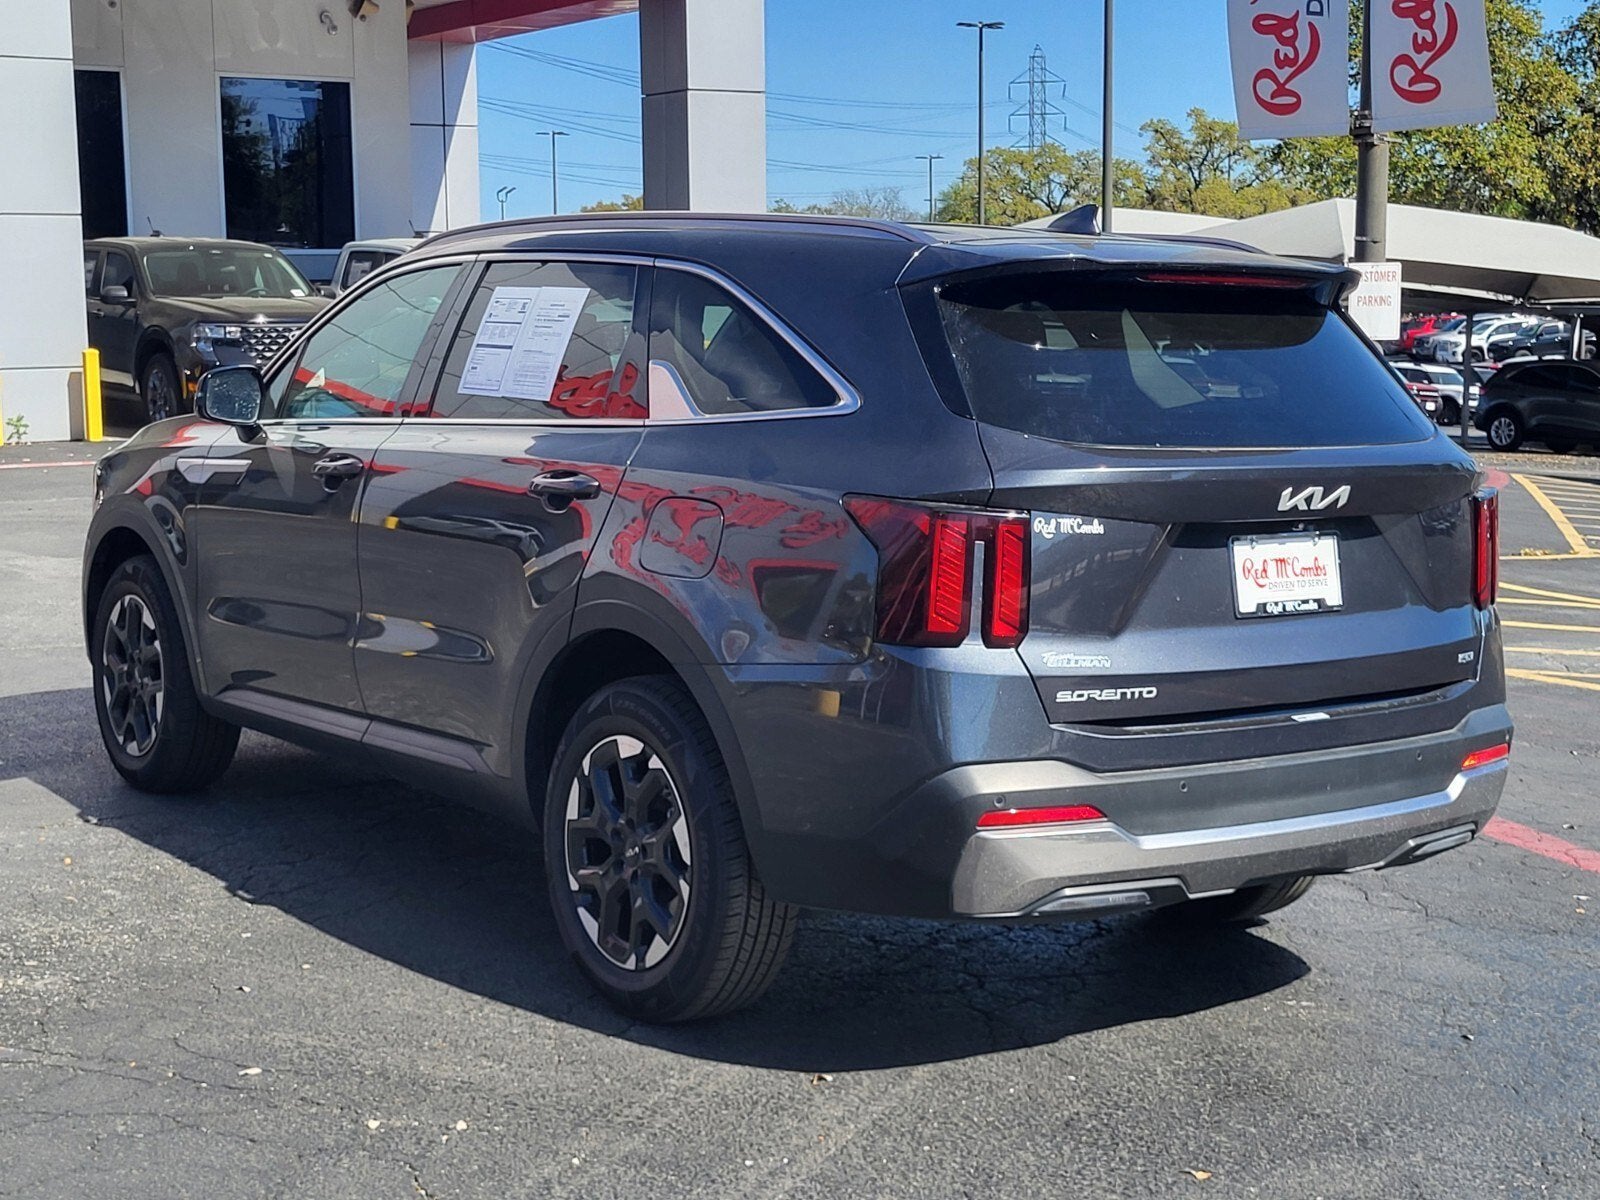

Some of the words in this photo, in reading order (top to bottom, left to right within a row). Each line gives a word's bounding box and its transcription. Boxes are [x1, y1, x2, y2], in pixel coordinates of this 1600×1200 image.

[1251, 9, 1321, 116] Red
[1390, 0, 1459, 104] Red
[1361, 271, 1397, 282] STOMER
[1356, 295, 1392, 307] PARKING
[1277, 485, 1351, 512] KIA
[1033, 517, 1057, 539] Red
[1242, 558, 1269, 588] Red
[1270, 556, 1327, 580] McCombs
[1268, 580, 1295, 590] DRIVEN
[1297, 580, 1307, 588] TO
[1308, 578, 1328, 588] SERVE
[1056, 686, 1157, 702] SORENTO
